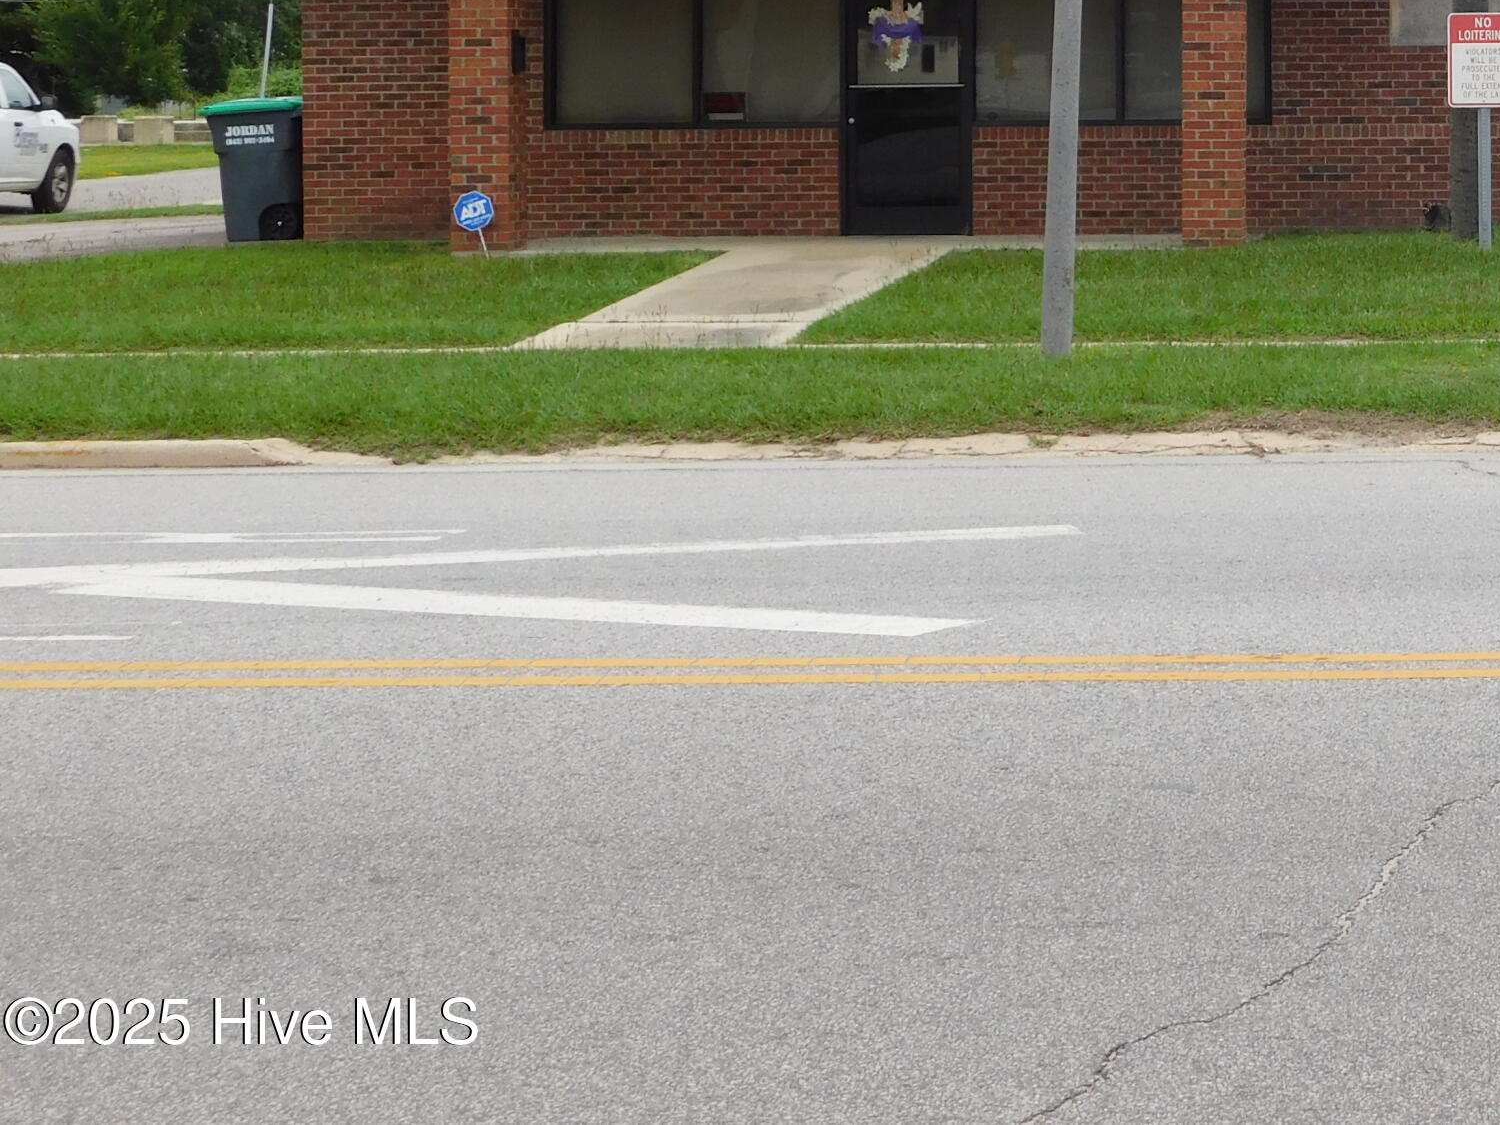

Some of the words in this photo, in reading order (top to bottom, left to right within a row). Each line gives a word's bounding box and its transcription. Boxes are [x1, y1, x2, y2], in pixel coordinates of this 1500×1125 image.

[1475, 18, 1491, 27] NO
[225, 124, 274, 137] JORDAN
[460, 199, 487, 221] ADT
